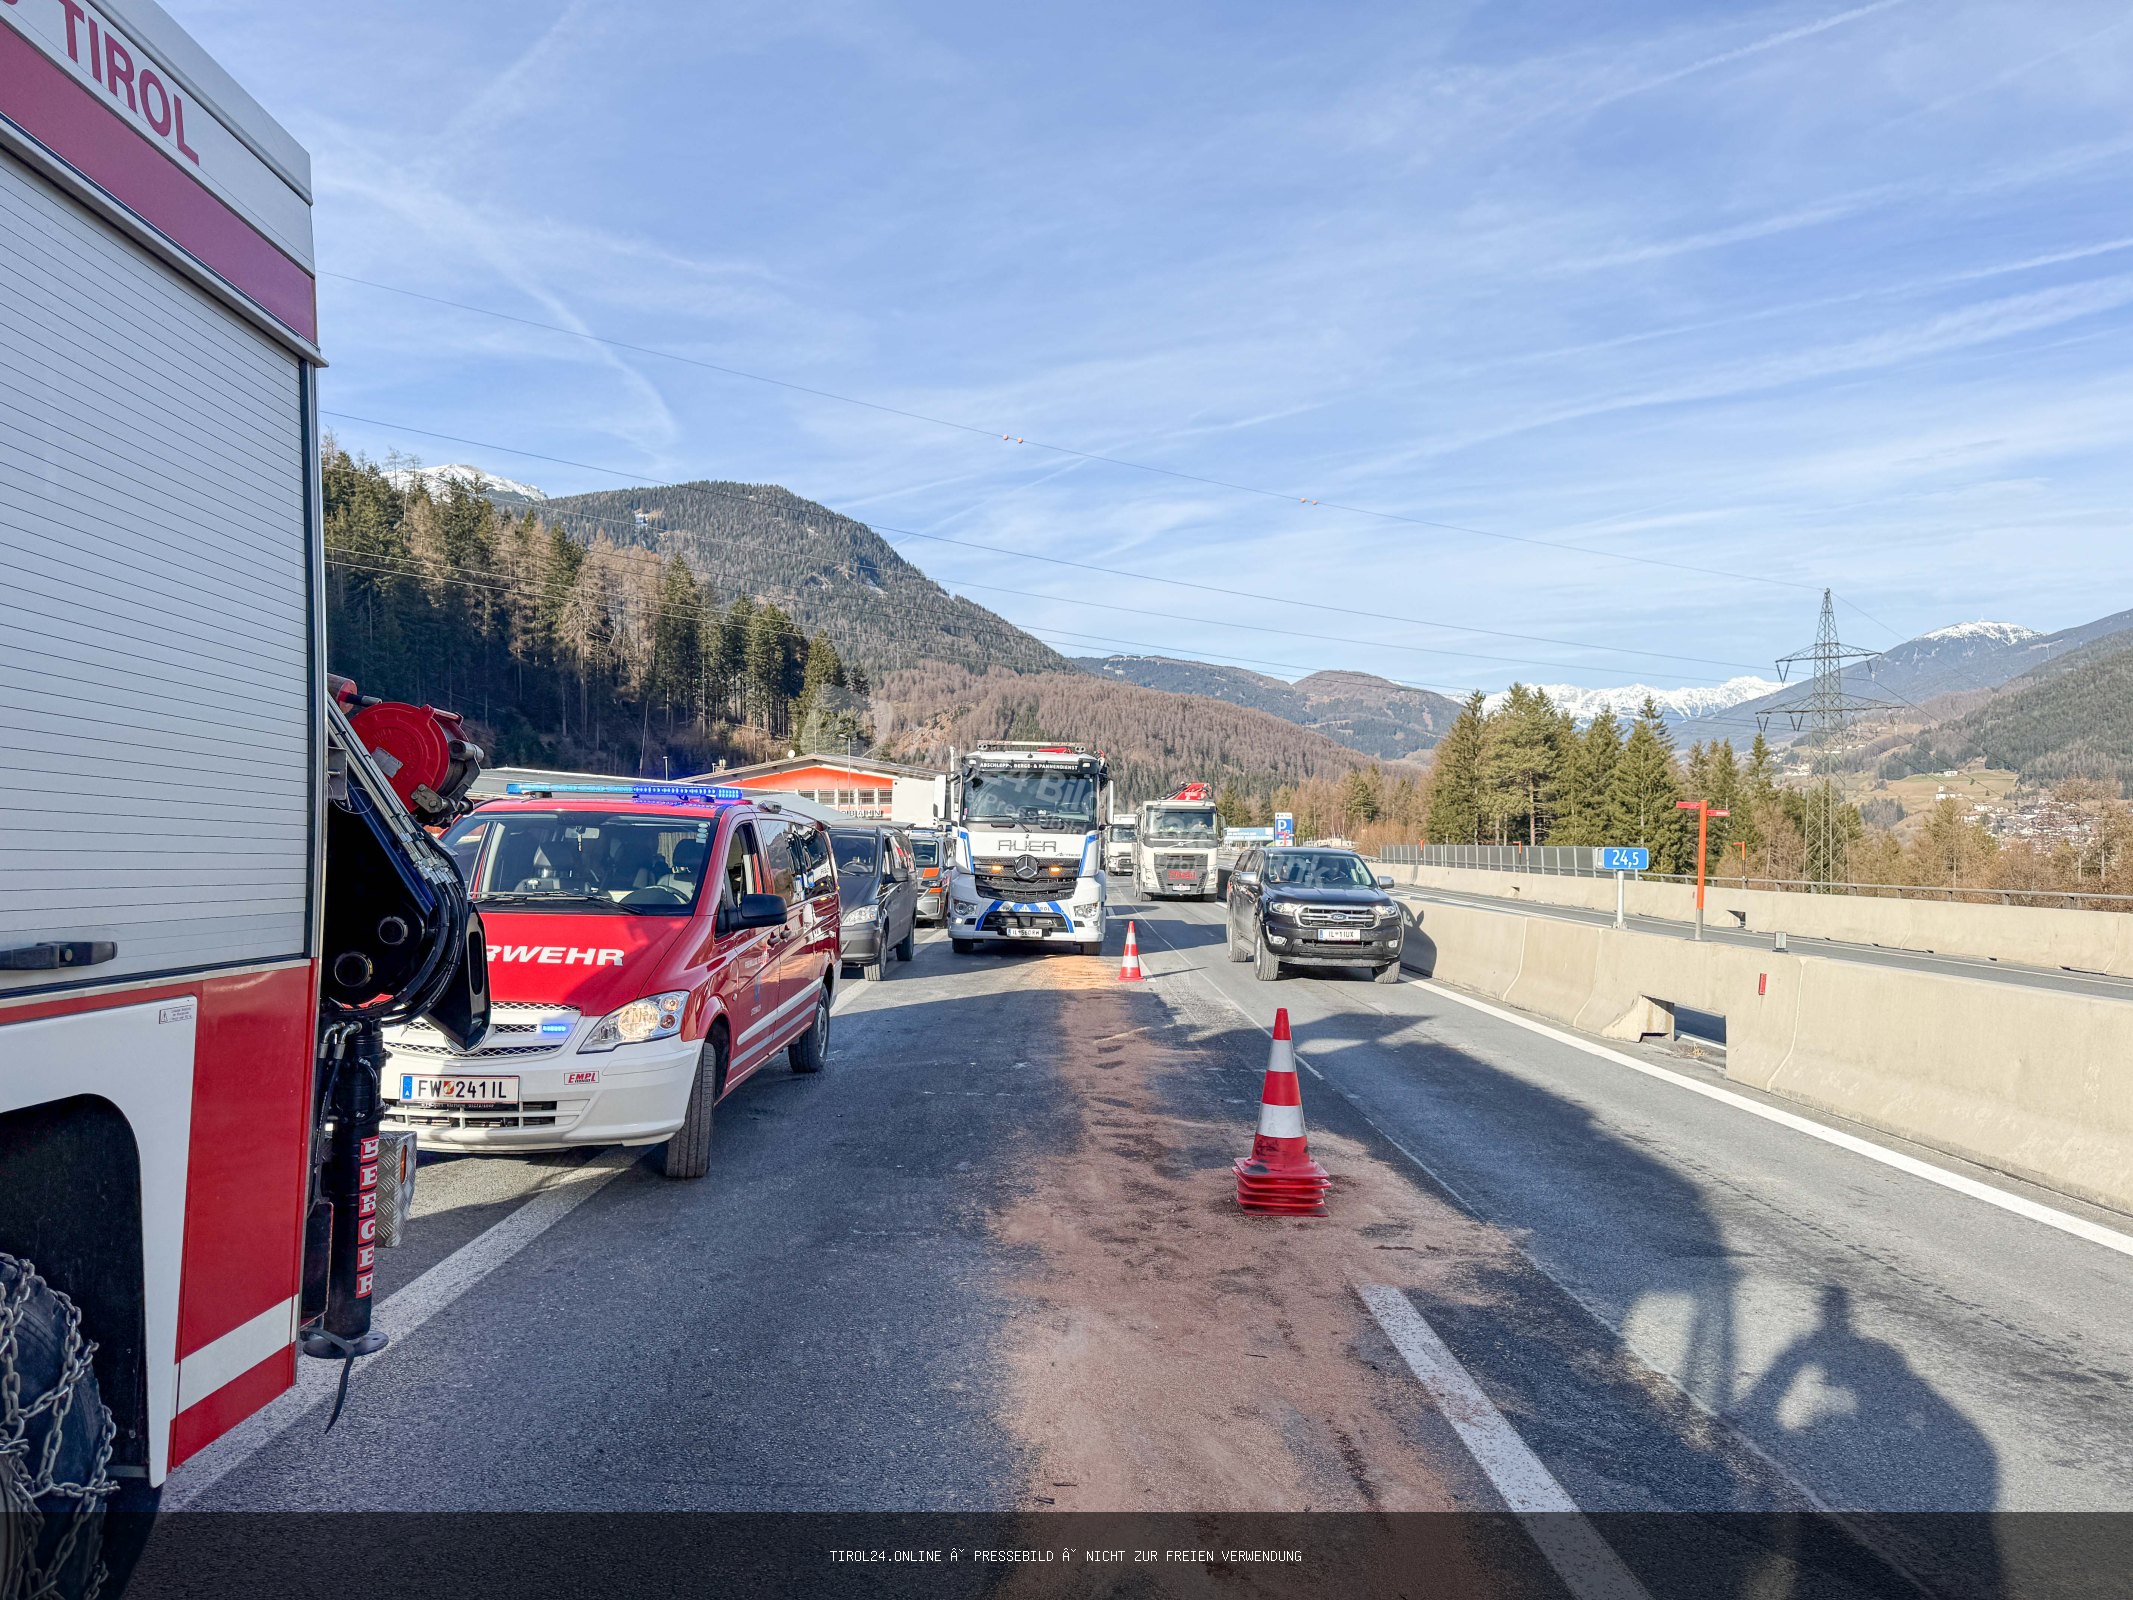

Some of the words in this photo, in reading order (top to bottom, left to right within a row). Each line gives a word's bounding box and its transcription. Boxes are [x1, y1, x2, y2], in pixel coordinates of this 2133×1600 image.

[59, 0, 200, 167] TIROL
[998, 839, 1057, 852] AUER
[1612, 849, 1639, 868] 24,5
[486, 945, 625, 967] RWEHR
[568, 1072, 596, 1083] EMPL
[418, 1080, 442, 1097] FW
[455, 1080, 507, 1099] 241IL
